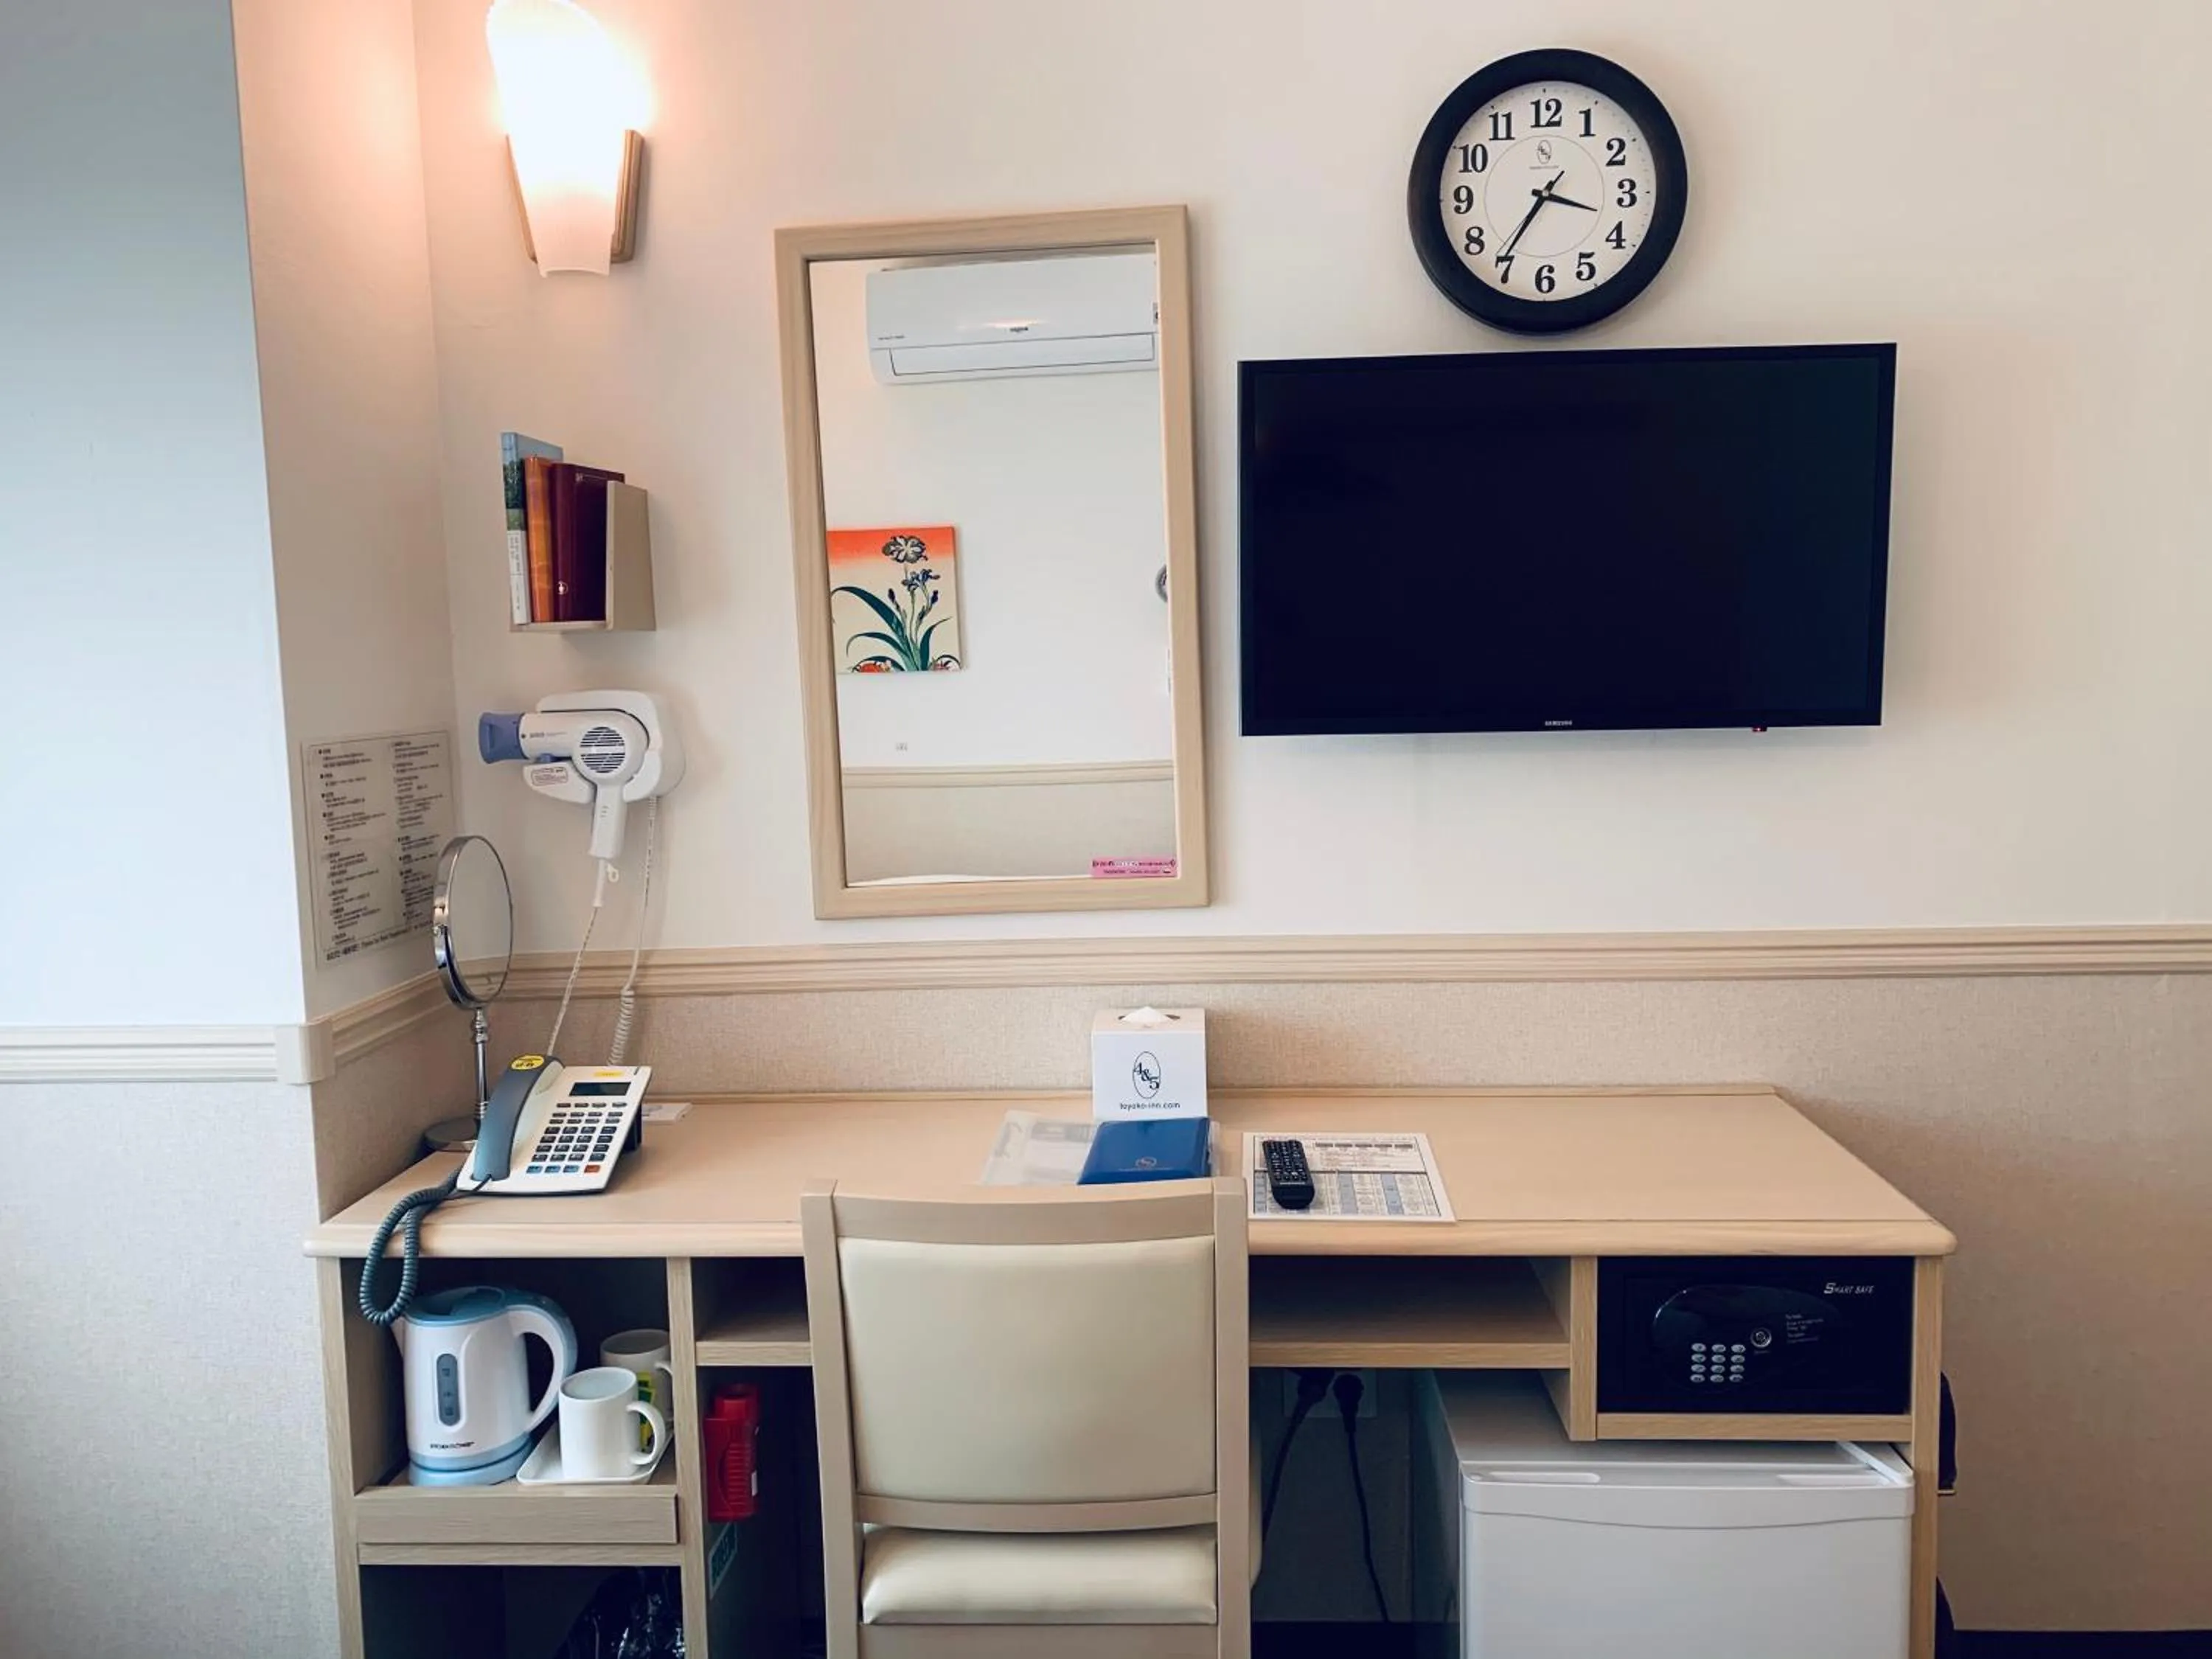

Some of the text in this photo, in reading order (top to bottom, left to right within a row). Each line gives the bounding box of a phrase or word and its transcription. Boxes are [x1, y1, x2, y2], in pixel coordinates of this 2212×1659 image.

[1489, 111, 1516, 141] 11
[1530, 98, 1563, 128] 12
[1579, 108, 1596, 138] 1
[1458, 143, 1489, 173] 10
[1605, 137, 1626, 167] 2
[1453, 185, 1474, 214] 9
[1616, 178, 1638, 208] 3
[1464, 226, 1485, 255] 8
[1604, 220, 1627, 249] 4
[1495, 255, 1515, 284] 7
[1534, 265, 1556, 293] 6
[1575, 251, 1596, 280] 5
